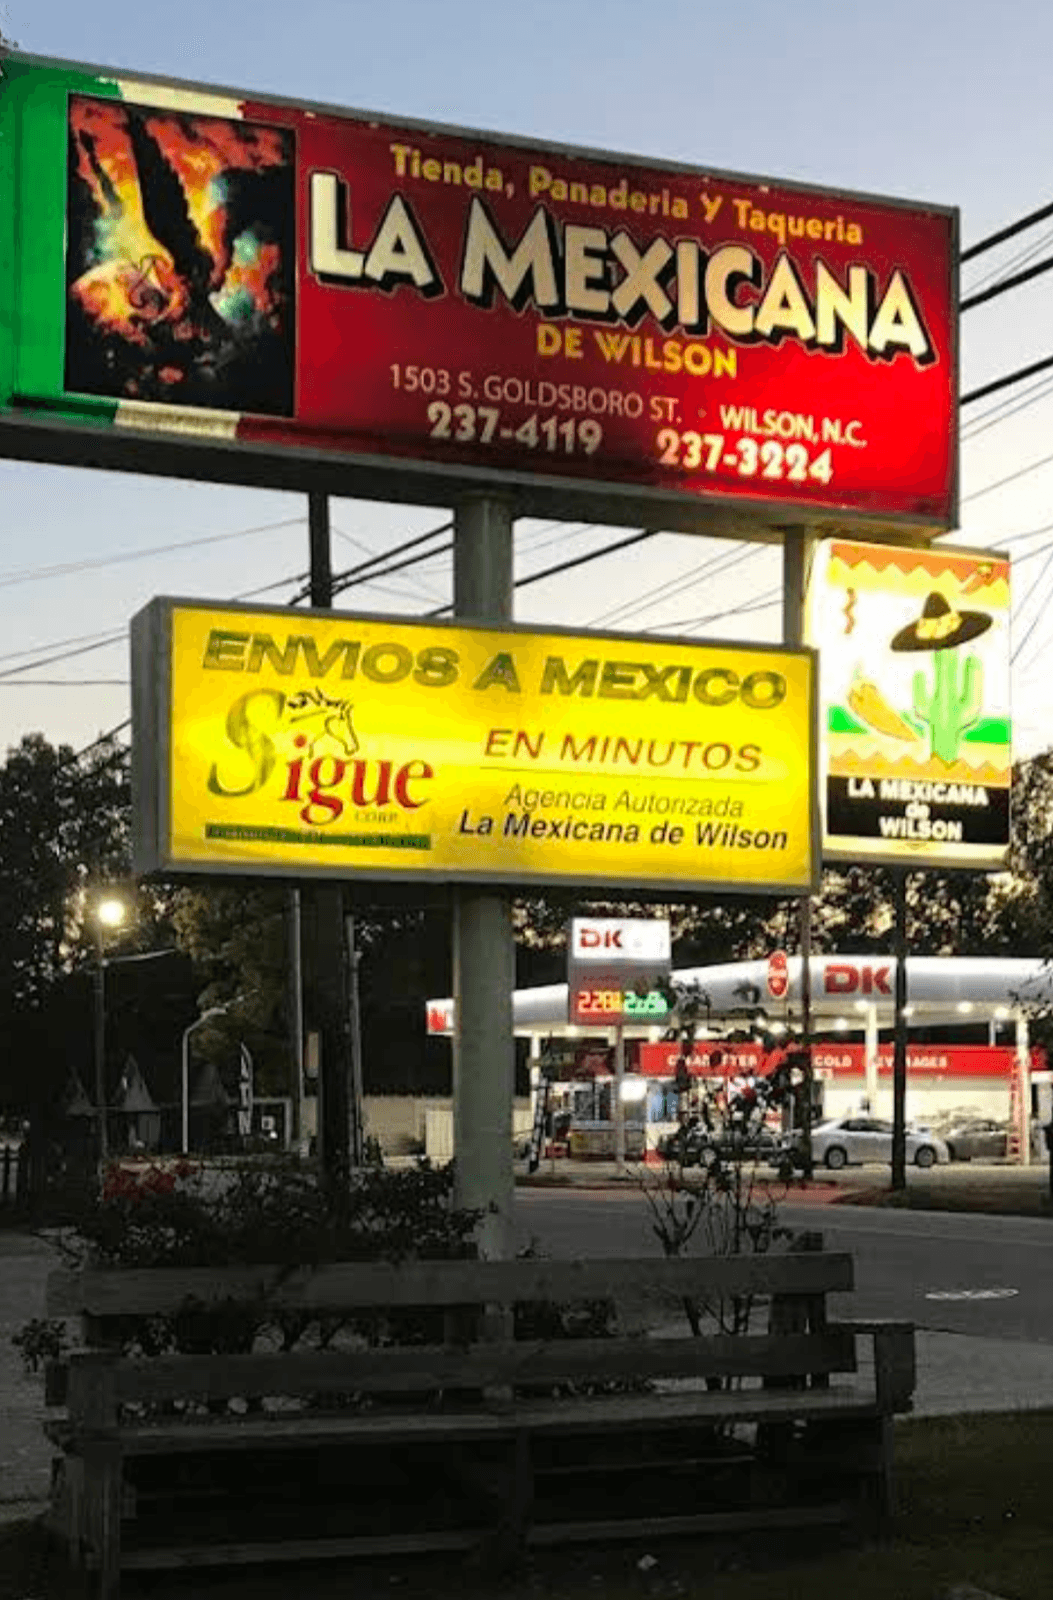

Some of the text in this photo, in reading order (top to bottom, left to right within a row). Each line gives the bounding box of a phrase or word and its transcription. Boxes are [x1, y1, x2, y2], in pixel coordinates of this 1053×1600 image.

[389, 143, 515, 198] Tienda,
[529, 165, 689, 218] Panaderia
[733, 199, 863, 245] Taqueria
[310, 172, 932, 361] LA MEXICANA
[536, 322, 738, 379] DE WILSON
[390, 363, 451, 395] 1503
[458, 371, 479, 399] S.
[484, 374, 644, 419] GOLDSBORO
[650, 396, 682, 424] ST.
[719, 403, 819, 445] WILSON,
[427, 400, 834, 485] 237-4119 237-3224
[202, 629, 788, 710] ENVIOS A MEXICO
[207, 687, 434, 826] Sigue
[484, 728, 763, 772] EN MINUTOS
[504, 782, 744, 818] Agencia Autorizada
[848, 777, 989, 806] LA MEXICANA
[459, 808, 788, 851] La Mexicana de Wilson
[879, 816, 963, 841] WILSON
[579, 927, 623, 949] DK
[824, 964, 893, 995] DK
